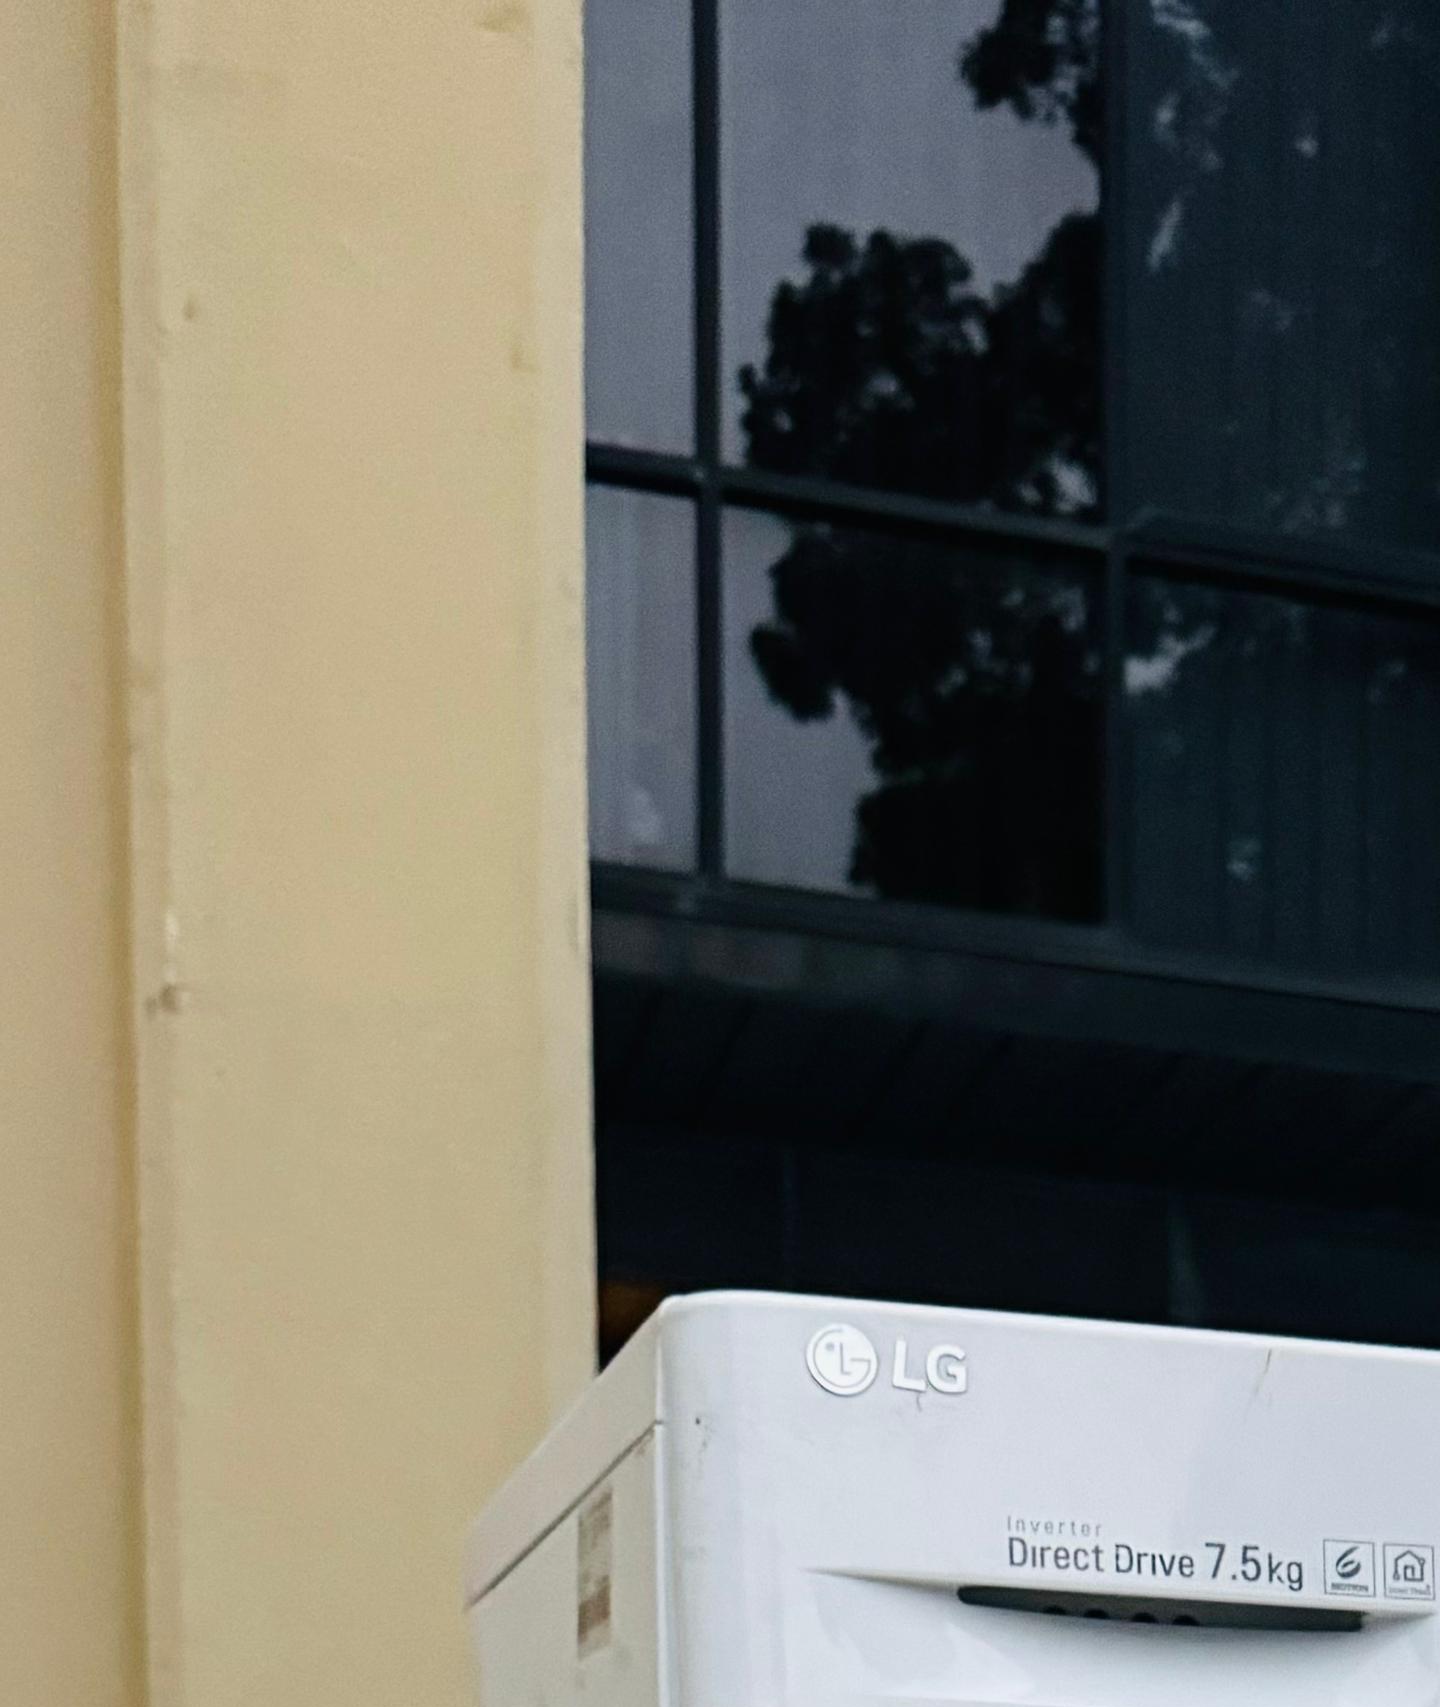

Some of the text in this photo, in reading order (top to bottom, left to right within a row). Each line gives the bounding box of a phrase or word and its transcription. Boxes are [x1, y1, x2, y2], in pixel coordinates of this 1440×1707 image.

[892, 1339, 968, 1394] LG
[1007, 1515, 1102, 1537] Inverter
[1008, 1537, 1105, 1572] Direct
[1115, 1544, 1195, 1578] Drive
